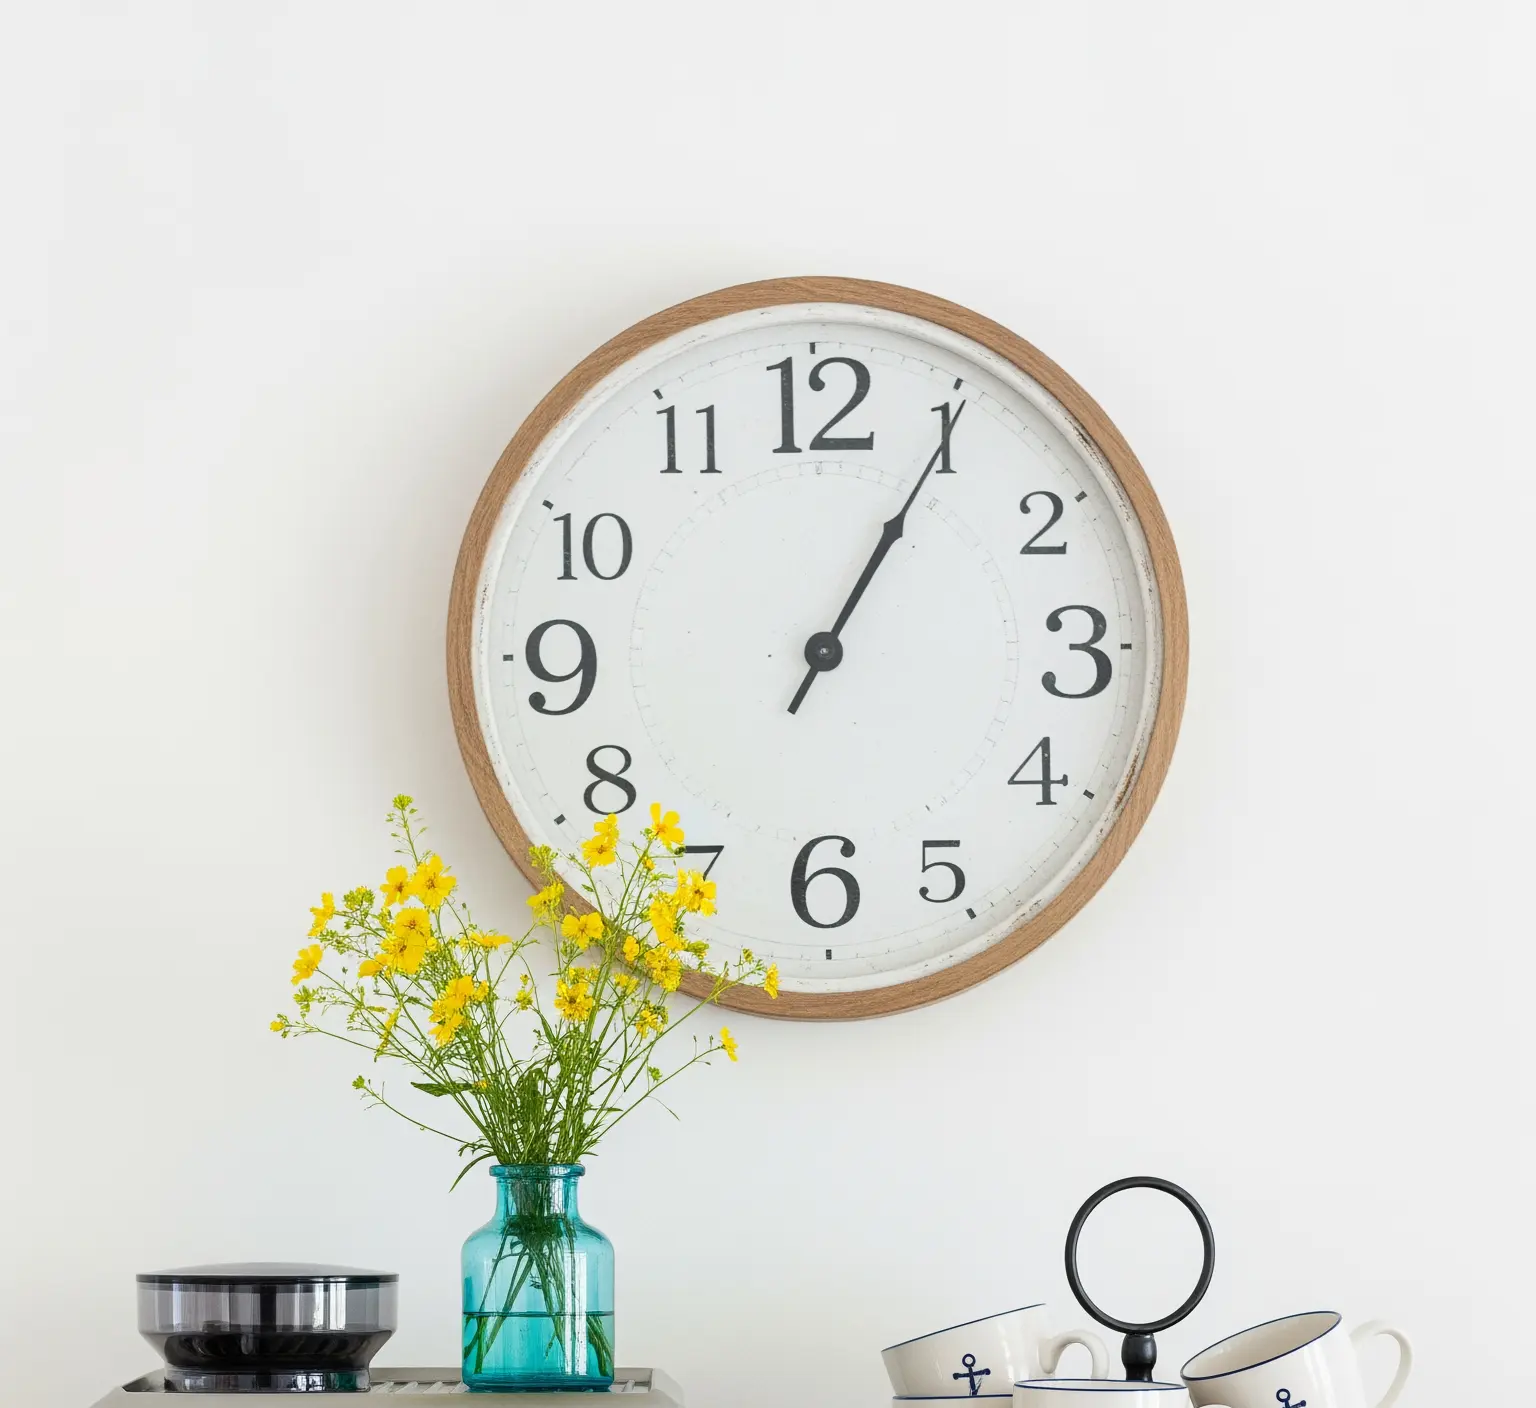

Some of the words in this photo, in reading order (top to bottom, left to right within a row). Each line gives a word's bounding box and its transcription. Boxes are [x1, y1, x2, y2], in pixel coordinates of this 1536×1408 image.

[657, 405, 723, 474] 11
[767, 356, 875, 454] 12
[930, 401, 958, 474] 1
[553, 512, 633, 581] 10
[1020, 490, 1068, 555] 2
[526, 619, 598, 716] 9
[1041, 604, 1113, 699] 3
[583, 744, 638, 816] 8
[1007, 736, 1069, 806] 4
[790, 835, 861, 929] 6
[918, 839, 967, 904] 5
